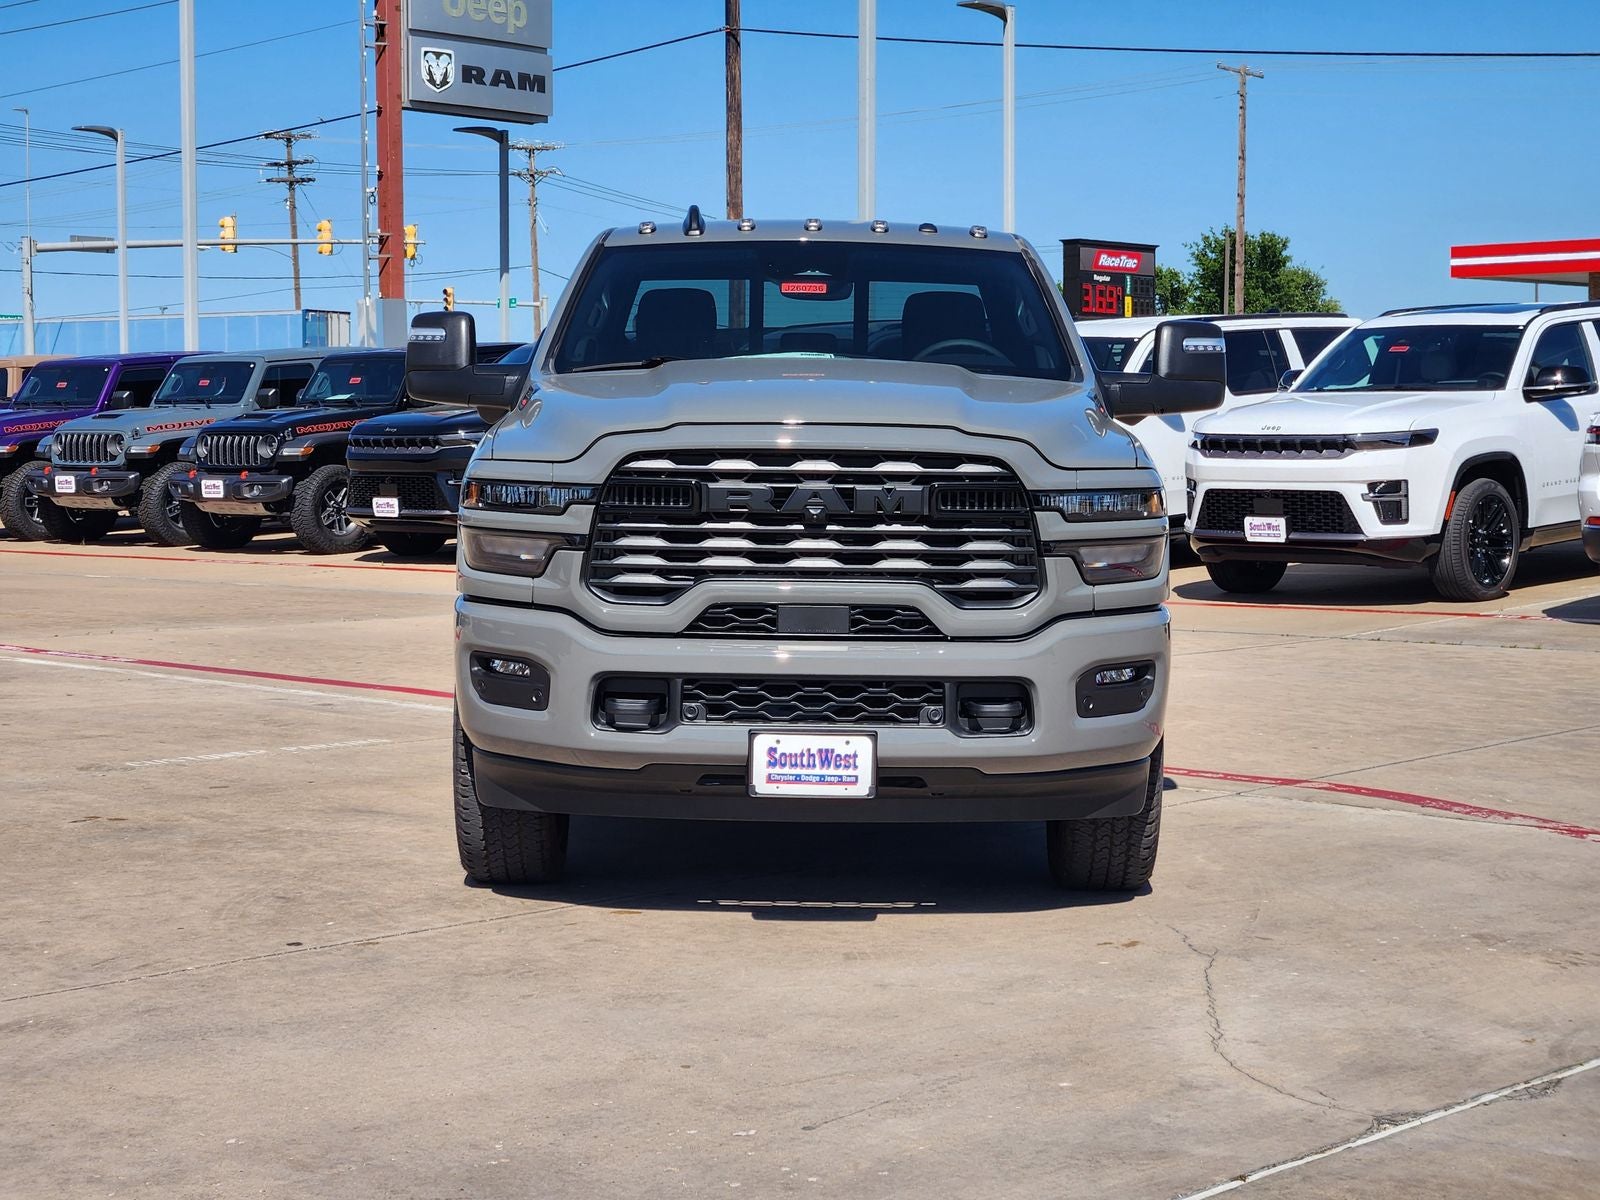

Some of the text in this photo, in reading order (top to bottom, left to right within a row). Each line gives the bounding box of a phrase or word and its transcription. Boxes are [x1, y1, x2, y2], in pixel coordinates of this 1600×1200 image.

[461, 64, 546, 94] RAM
[1098, 254, 1138, 268] RaceTrac
[1261, 424, 1282, 432] Jeep
[705, 483, 925, 515] RAM
[766, 746, 859, 771] SouthWest
[770, 773, 796, 782] Chrysler
